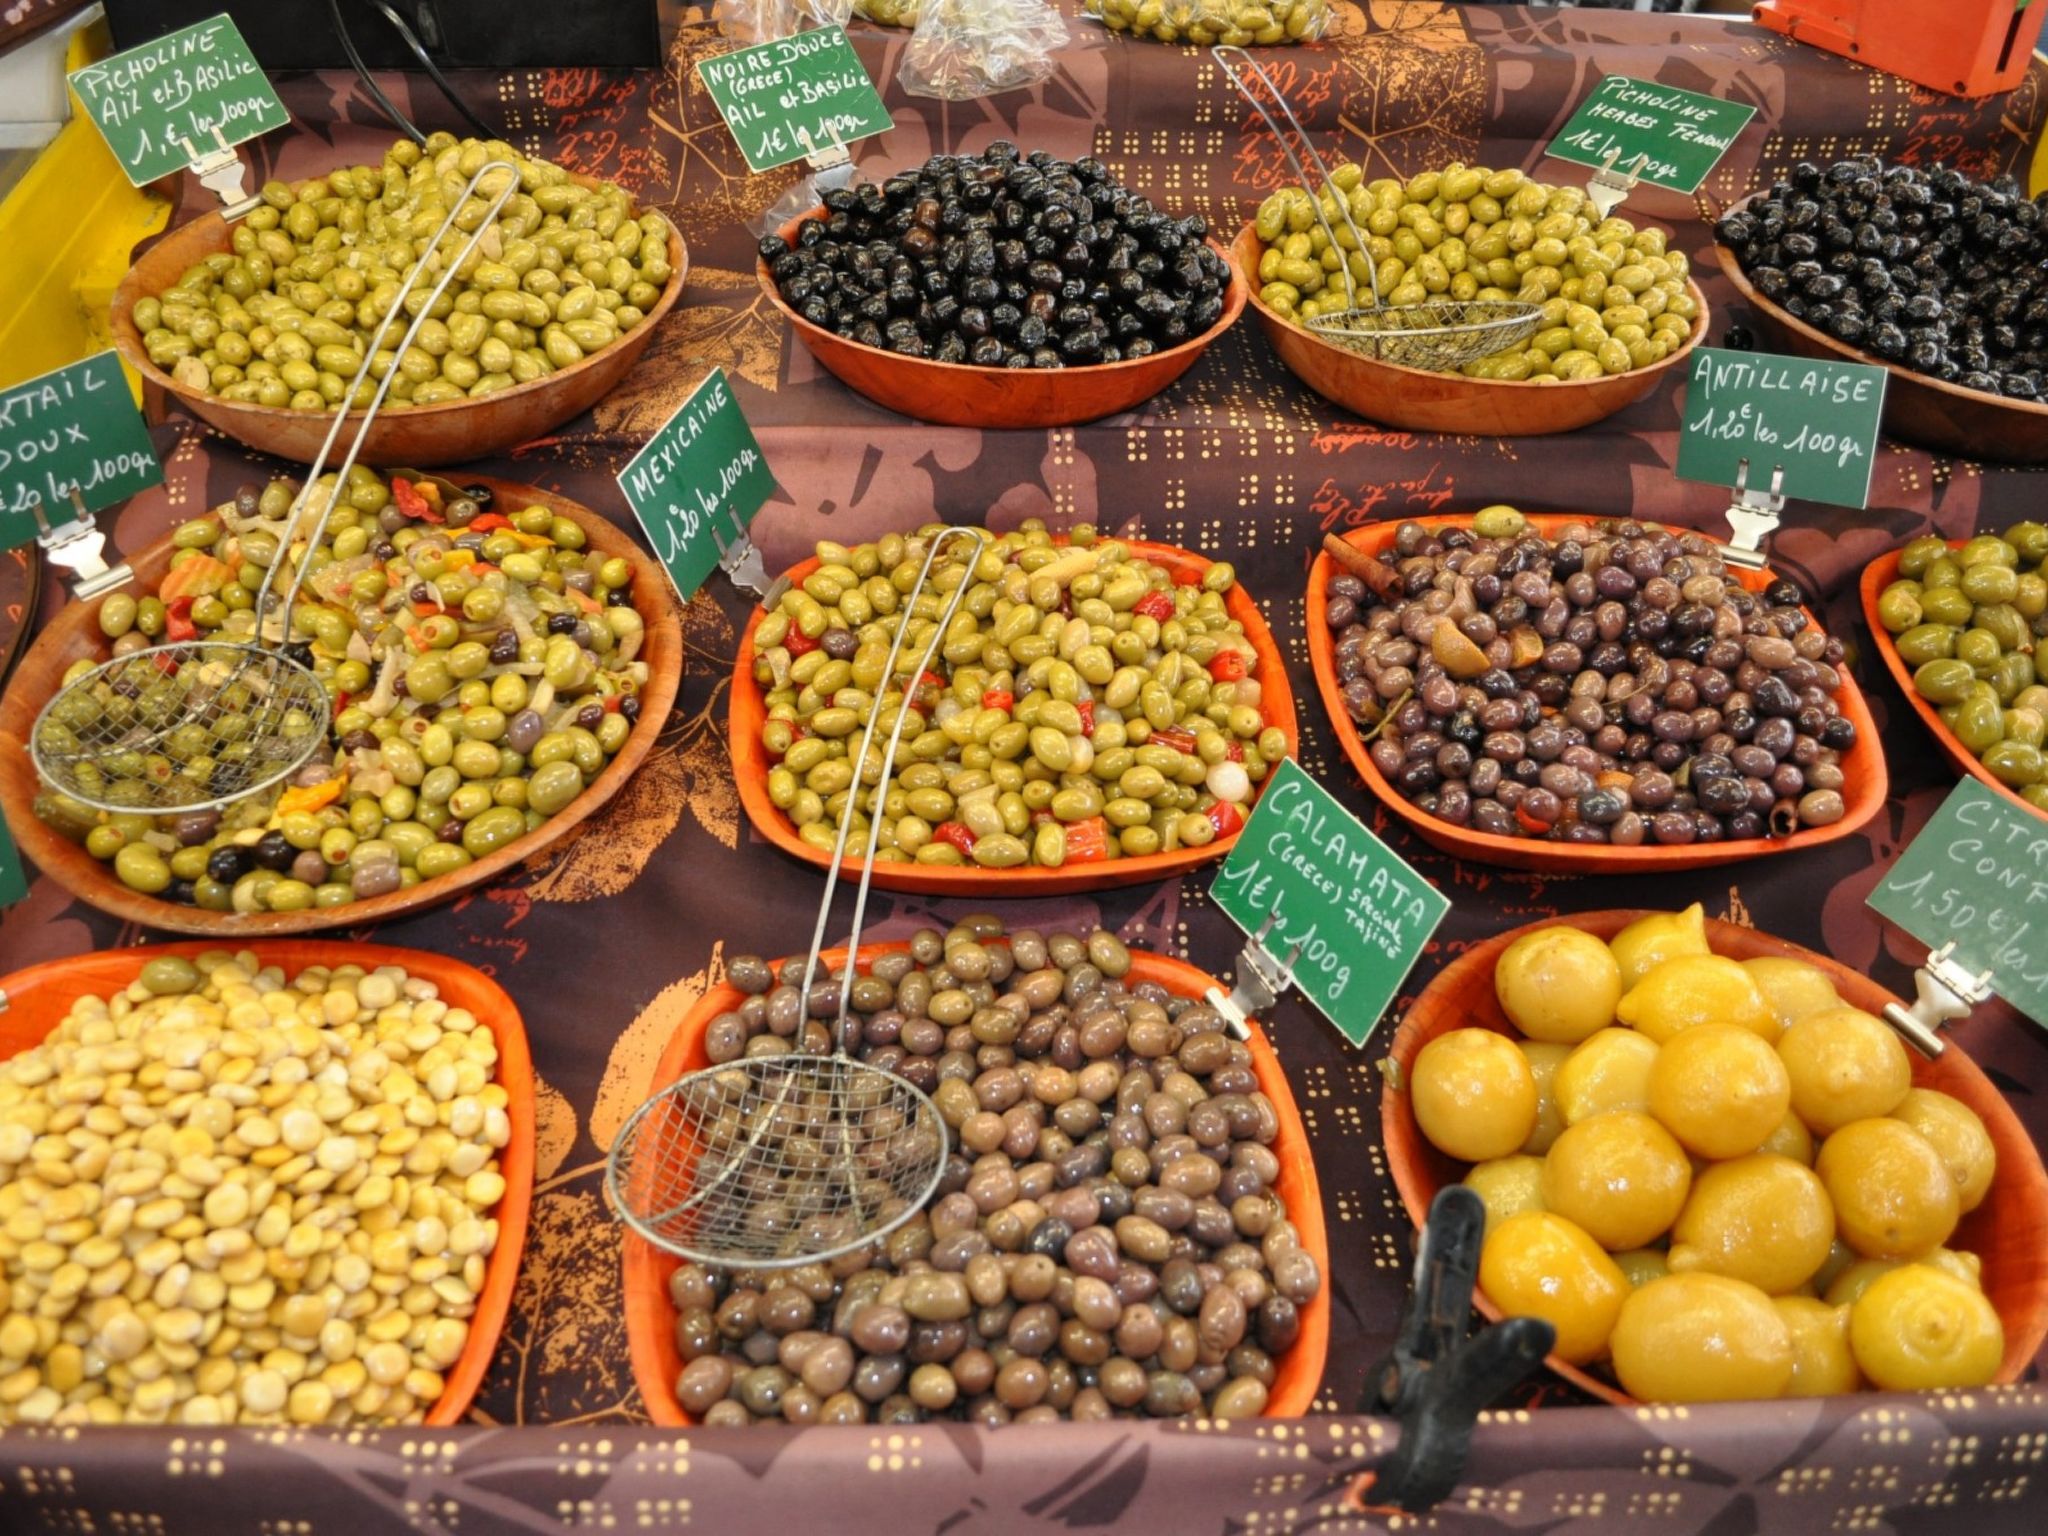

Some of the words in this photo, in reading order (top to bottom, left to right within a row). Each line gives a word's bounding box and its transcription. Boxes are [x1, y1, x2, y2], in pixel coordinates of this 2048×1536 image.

[777, 32, 844, 65] DOUCE
[153, 79, 175, 104] et
[729, 66, 792, 99] (GRECE)
[779, 89, 799, 109] et
[756, 127, 788, 159] 1€
[1564, 129, 1602, 150] 1€
[1618, 151, 1678, 179] 10gr
[1754, 412, 1778, 444] les
[696, 488, 719, 518] les
[1268, 781, 1426, 927] CALAMATA
[1947, 839, 2048, 903] CONF
[1224, 859, 1272, 908] 1€
[1283, 923, 1350, 999] 100g
